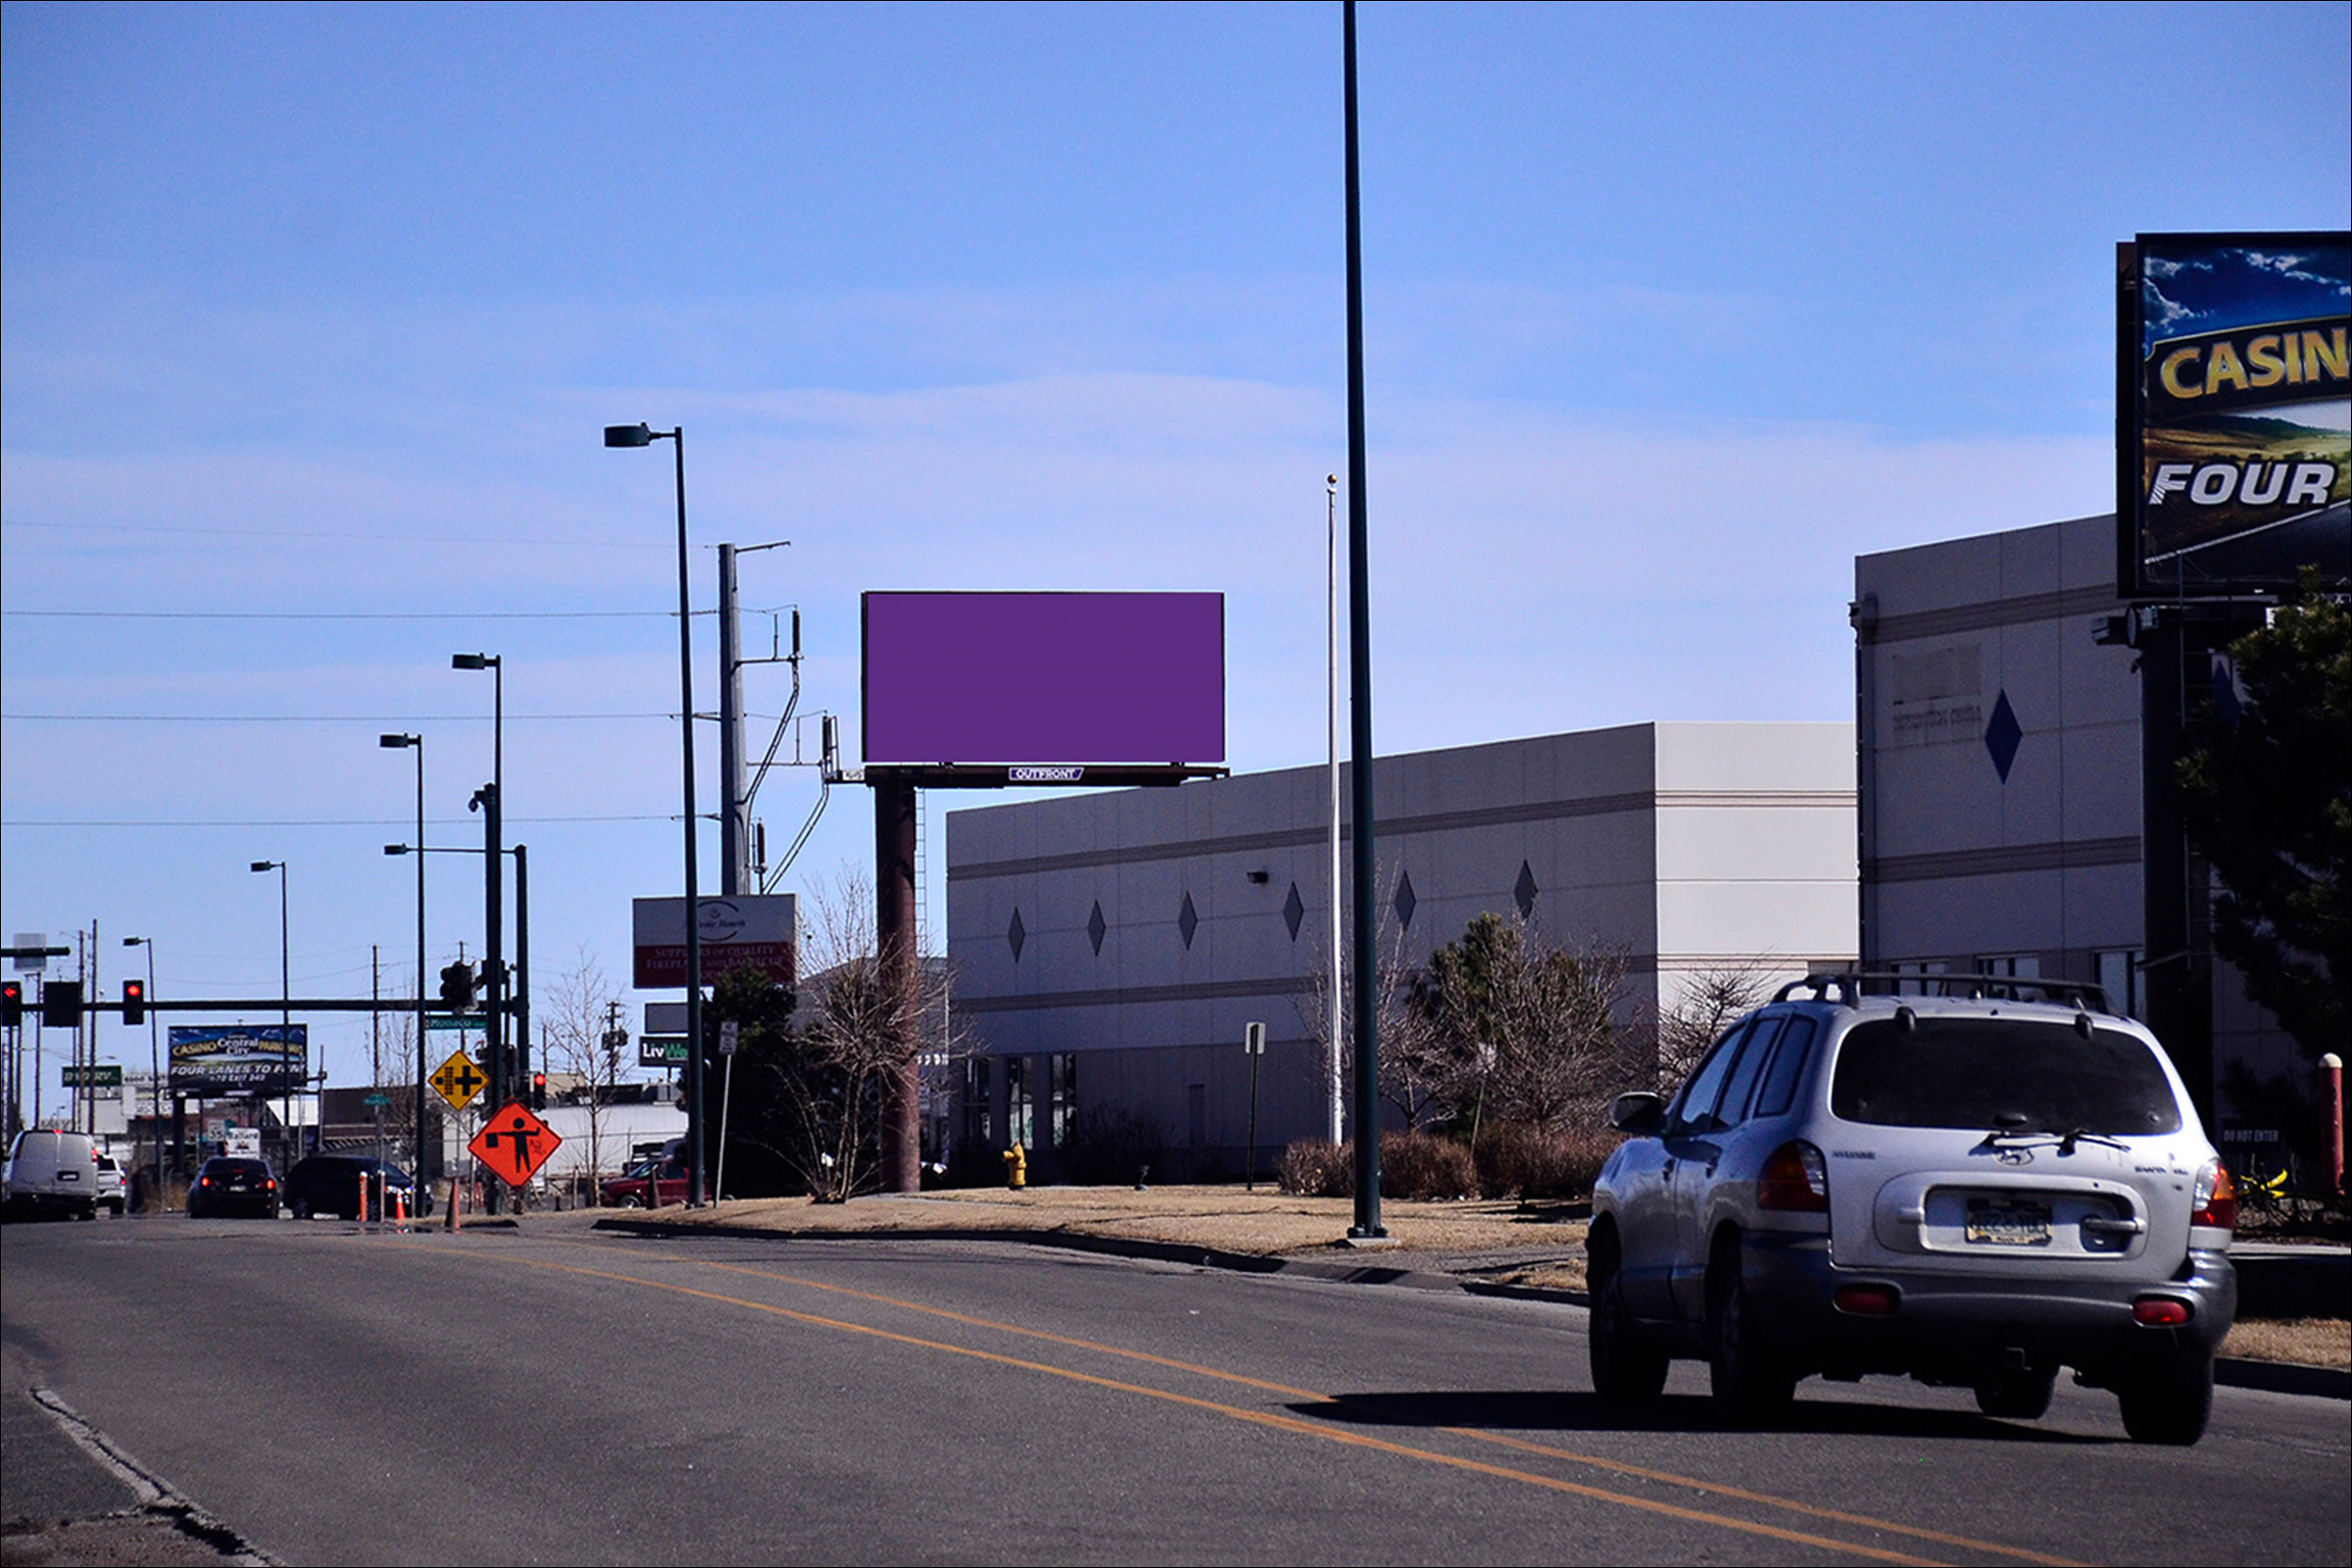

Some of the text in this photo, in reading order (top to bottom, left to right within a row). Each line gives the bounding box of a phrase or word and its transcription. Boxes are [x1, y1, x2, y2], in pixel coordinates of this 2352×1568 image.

[2159, 327, 2351, 399] CASIN
[2148, 463, 2335, 506] FOUR
[1015, 768, 1075, 780] OUTFRONT
[172, 1041, 217, 1056] CASINO
[217, 1038, 258, 1050] Central
[225, 1047, 250, 1058] City
[171, 1064, 205, 1076] FOUR
[209, 1063, 251, 1074] LANES
[255, 1063, 270, 1074] TO
